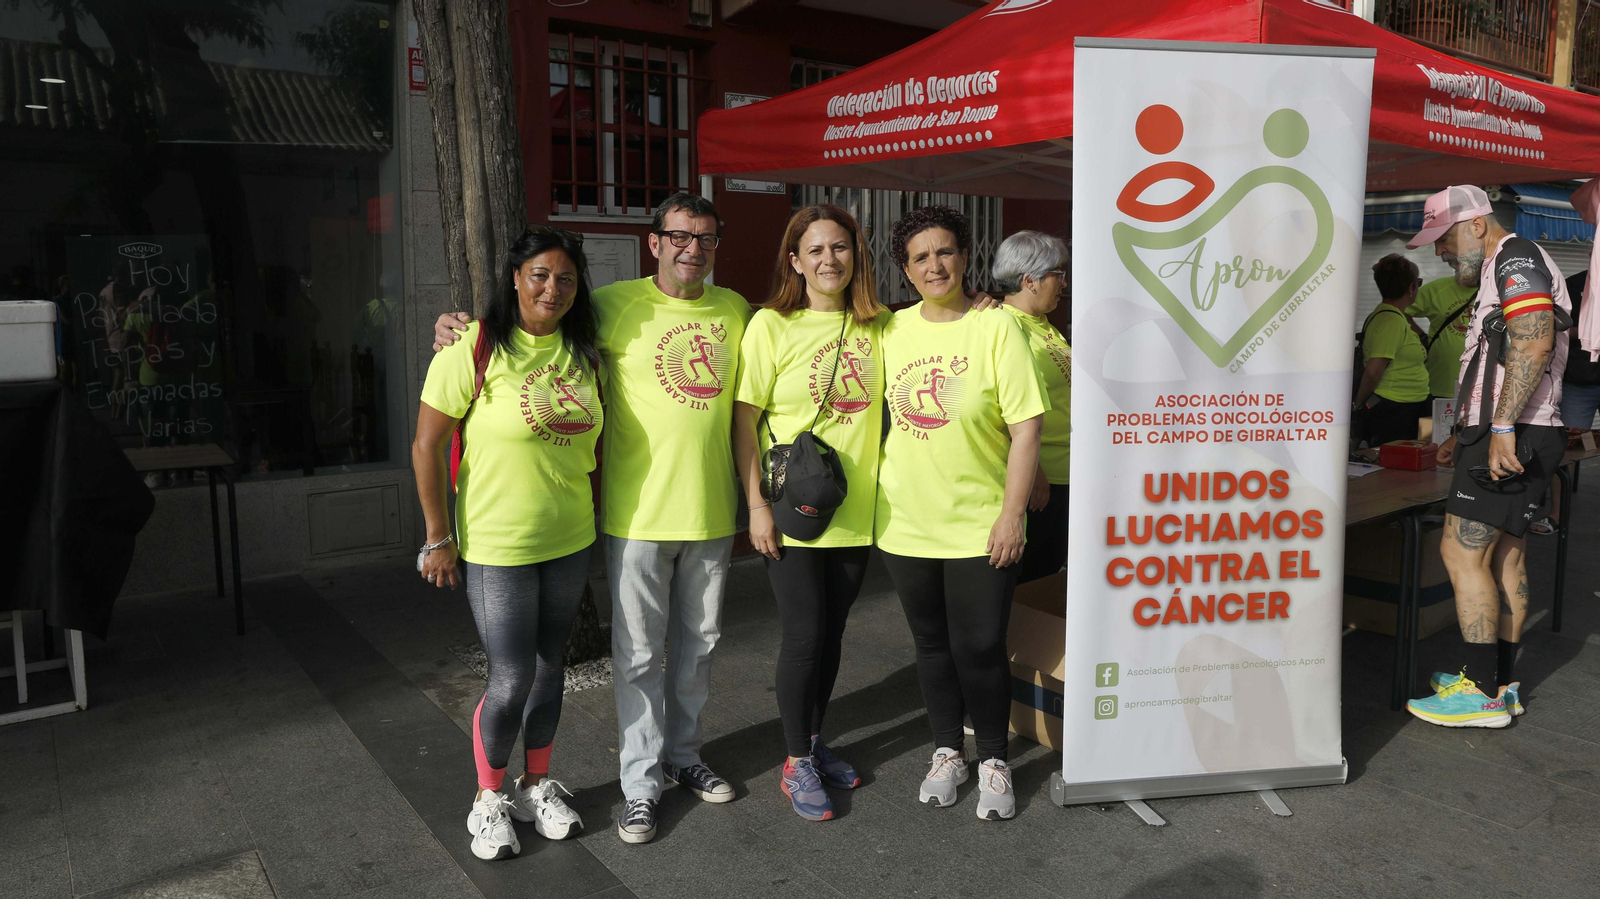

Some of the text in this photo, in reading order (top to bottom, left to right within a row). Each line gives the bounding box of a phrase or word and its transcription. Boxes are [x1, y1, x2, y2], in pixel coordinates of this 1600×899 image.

[827, 70, 1000, 117] Delegación de Deportes
[823, 104, 999, 141] Ilustre Ayuntamiento de San Roque
[1423, 98, 1450, 125] Ilustre
[129, 259, 190, 294] Hoy
[1158, 237, 1291, 312] Apron
[1229, 263, 1337, 374] CAMPO DE GIBRALTAR
[83, 338, 216, 381] Tapas y
[654, 322, 709, 411] VII CARRERA POPULAR
[811, 338, 849, 370] POPULAR
[895, 355, 943, 381] POPULAR
[86, 373, 223, 426] Empanadas
[520, 364, 571, 446] VII CARRERA POPULAR
[1155, 391, 1284, 408] ASOCIACIÓN DE
[138, 411, 213, 438] Varias
[836, 416, 853, 425] VII
[912, 428, 929, 440] VII
[1107, 408, 1334, 427] PROBLEMAS ONCOLÓGICOS
[1112, 428, 1328, 445] DEL CAMPO DE GIBRALTAR
[1144, 469, 1290, 503] UNIDOS
[1106, 509, 1324, 546] LUCHAMOS
[1106, 550, 1320, 587] CONTRA EL
[1132, 588, 1291, 627] CÁNCER
[1126, 657, 1326, 677] Asociación de Problemas Oncológicos Apron
[1124, 693, 1233, 709] aproncampodegibraltar
[1482, 700, 1505, 710] HOKA
